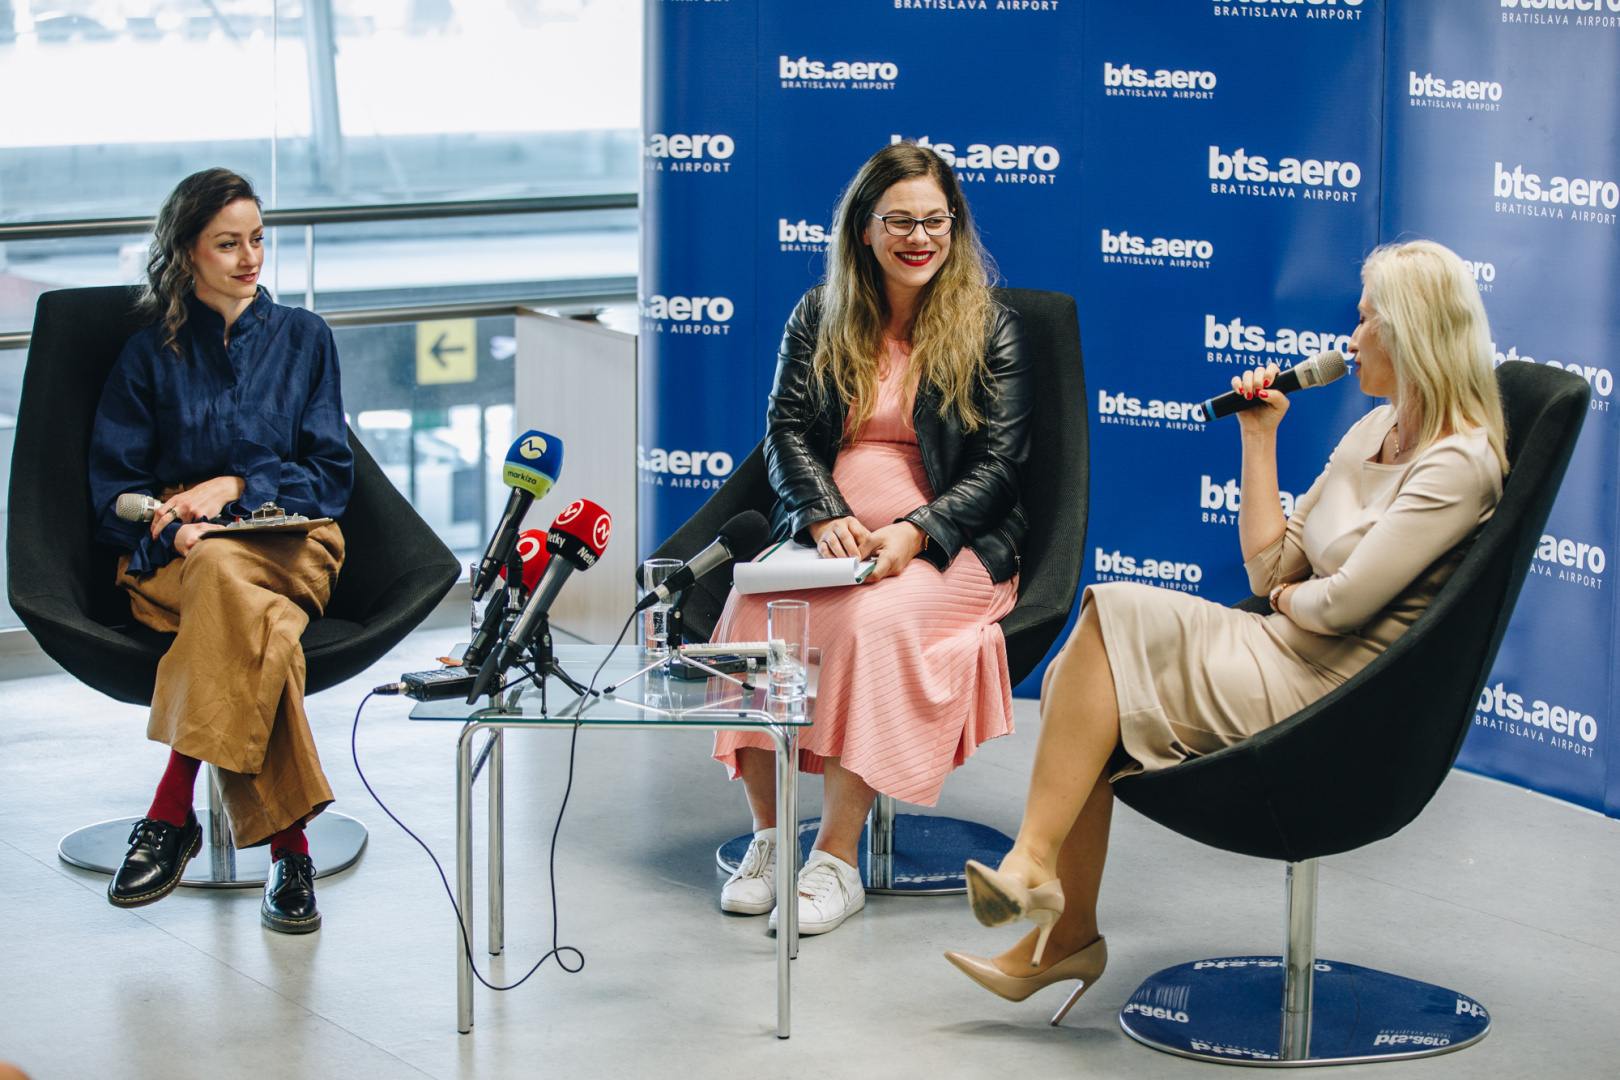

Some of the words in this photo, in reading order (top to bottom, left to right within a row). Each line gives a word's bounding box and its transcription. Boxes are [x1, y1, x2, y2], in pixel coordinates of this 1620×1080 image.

[894, 0, 987, 10] BRATISLAVA
[996, 0, 1058, 11] AIRPORT
[1214, 6, 1298, 18] BRATISLAVA
[1306, 9, 1362, 20] AIRPORT
[1502, 12, 1569, 25] BRATISLAVA
[779, 55, 898, 80] bts.aero
[1104, 62, 1217, 90] bts.aero
[781, 81, 846, 89] BRATISLAVA
[851, 82, 896, 90] AIRPORT
[1105, 88, 1168, 98] BRATISLAVA
[1172, 91, 1214, 99] AIRPORT
[1409, 71, 1502, 101] bts.aero
[1410, 98, 1462, 109] BRATISLAVA
[1467, 102, 1501, 112] AIRPORT
[644, 133, 735, 159] .aero
[670, 162, 731, 172] AIRPORT
[1208, 145, 1361, 188] bts.aero
[994, 173, 1056, 185] AIRPORT
[1494, 161, 1620, 209] bts.aero
[1210, 183, 1296, 198] BRATISLAVA
[1303, 189, 1358, 203] AIRPORT
[1495, 202, 1564, 219] BRATISLAVA
[1571, 210, 1617, 225] AIRPORT
[779, 218, 832, 243] bts.
[1101, 229, 1214, 260] bts.aero
[1103, 255, 1165, 266] BRATISLAVA
[1169, 260, 1211, 269] AIRPORT
[670, 323, 731, 335] AIRPORT
[1205, 314, 1356, 361] bts.aero
[1098, 389, 1207, 422] bts.aero
[1100, 415, 1161, 428] BRATISLAVA
[1165, 421, 1207, 432] AIRPORT
[508, 471, 537, 485] markiza
[1095, 547, 1203, 583] bts.aero
[1558, 570, 1602, 589] AIRPORT
[1475, 714, 1545, 743] BRATISLAVA
[1551, 736, 1595, 758] AIRPORT
